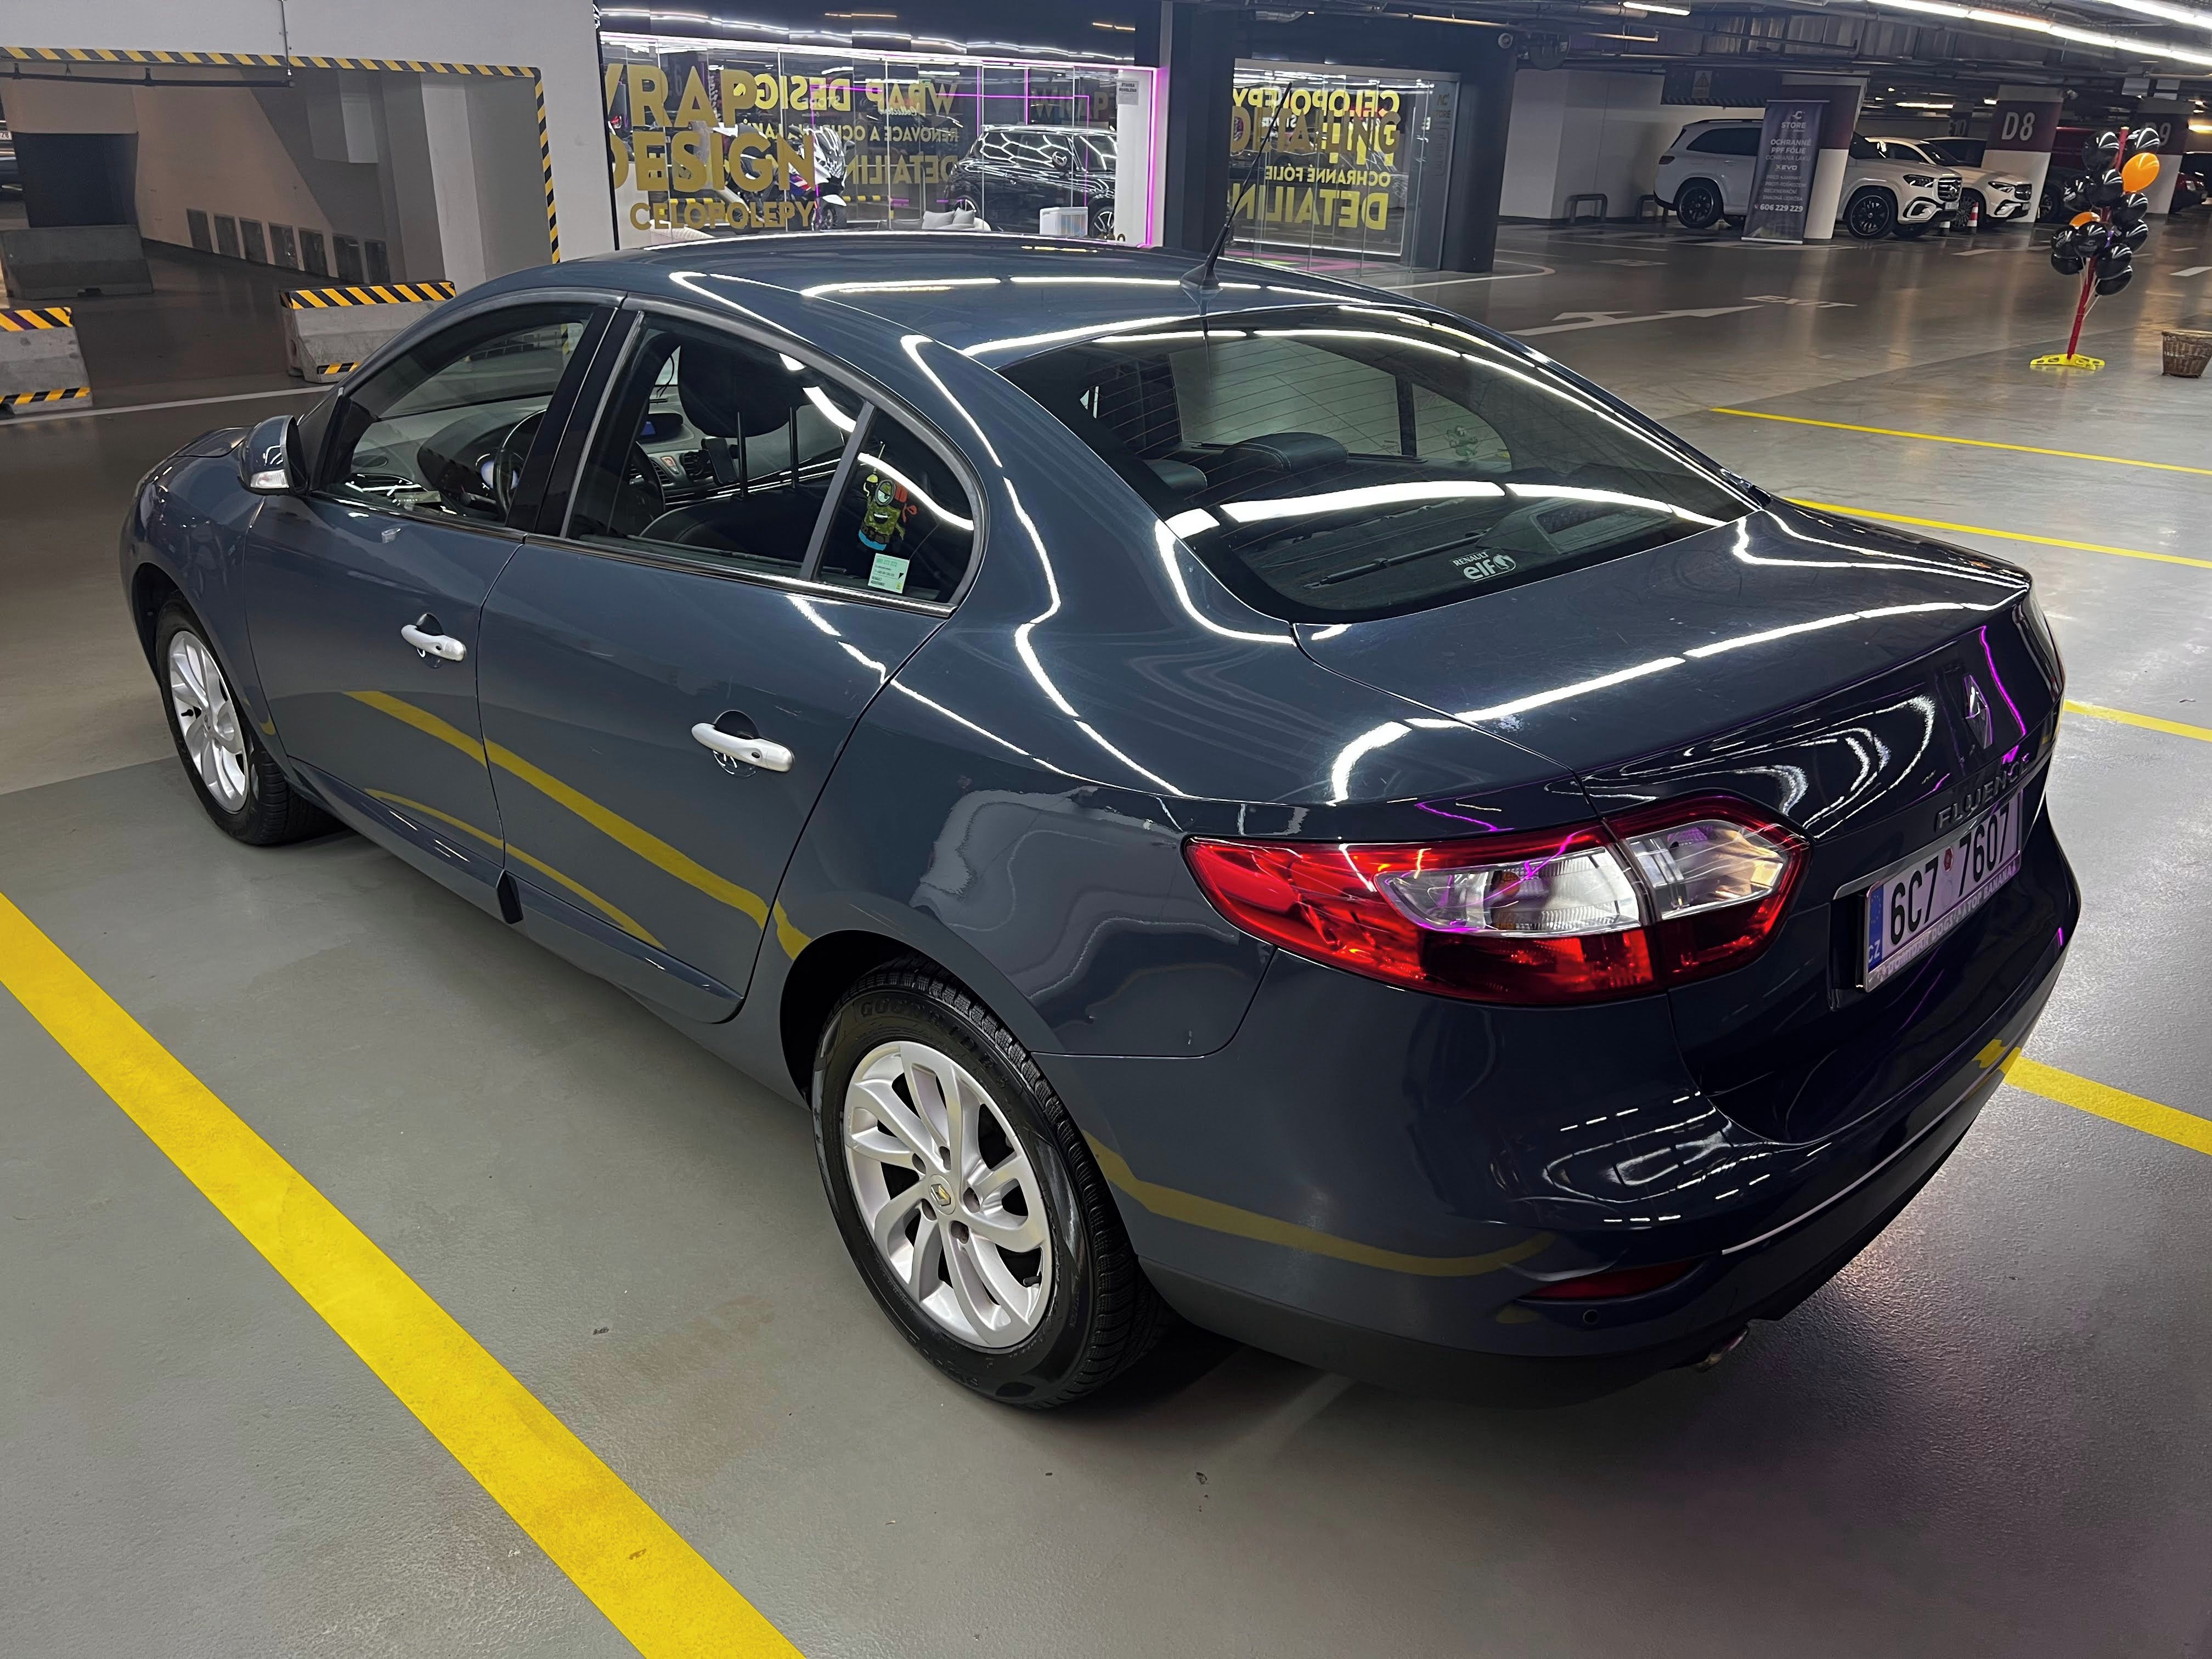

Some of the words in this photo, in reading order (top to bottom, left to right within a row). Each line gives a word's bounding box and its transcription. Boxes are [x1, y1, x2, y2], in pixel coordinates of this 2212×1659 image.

[1231, 105, 1401, 154] DETAILING
[2001, 112, 2035, 141] D8
[1770, 138, 1812, 146] OCHRANNÉ
[1786, 146, 1807, 154] FÓLIE
[630, 201, 815, 231] CELOPOLEPY
[1453, 551, 1489, 567] RENAULT
[1463, 559, 1496, 579] elf
[1935, 753, 2030, 831] FLUENCE
[1891, 855, 1939, 946] 6C7
[1959, 806, 2010, 899] 7607
[1868, 939, 1881, 964] CZ
